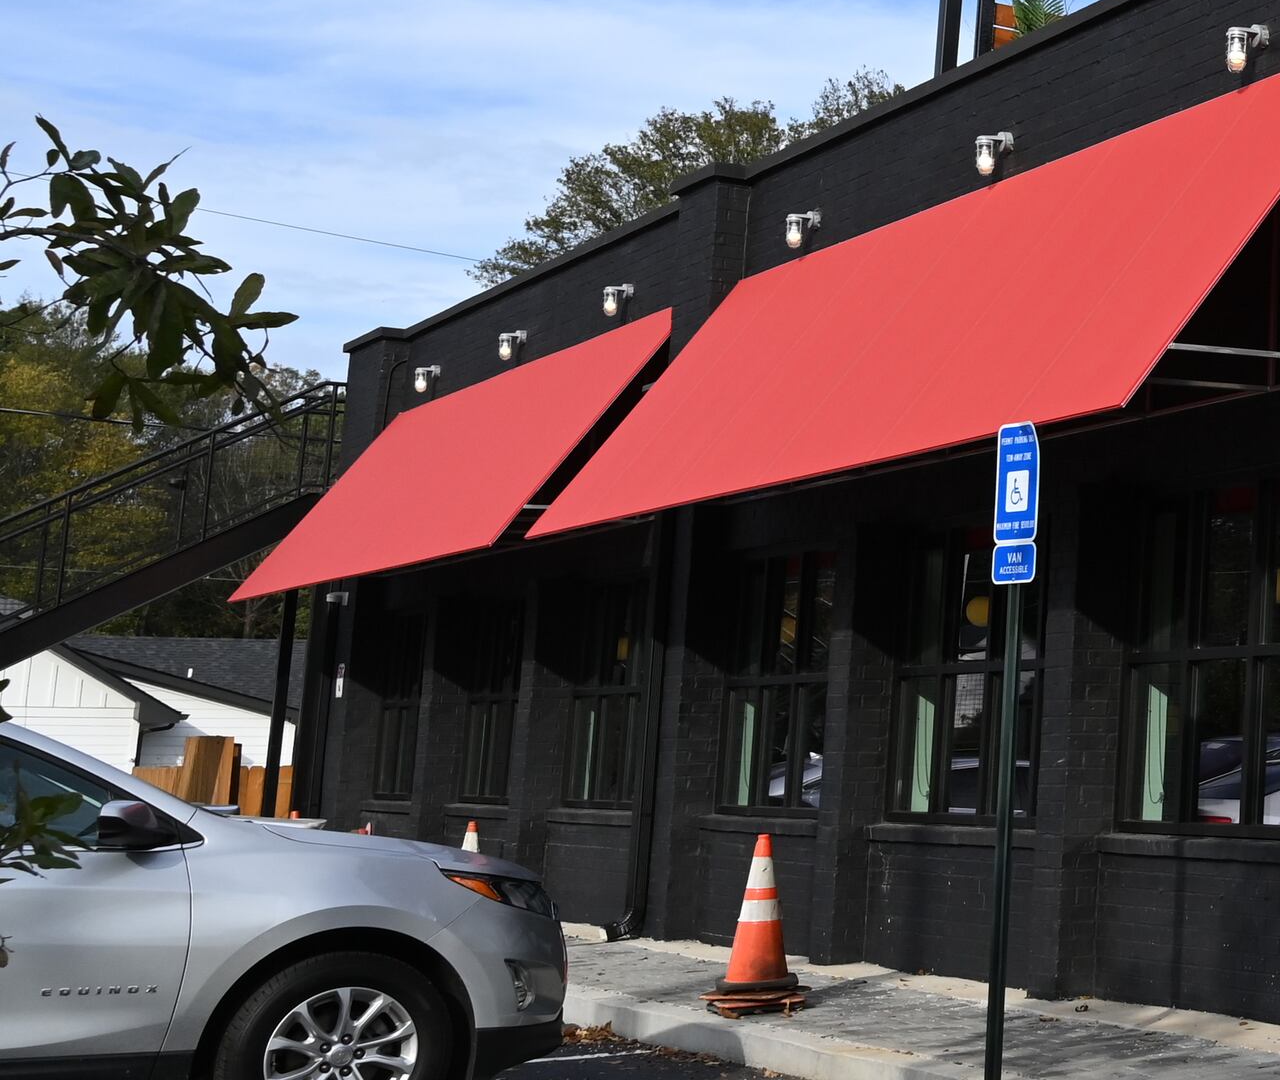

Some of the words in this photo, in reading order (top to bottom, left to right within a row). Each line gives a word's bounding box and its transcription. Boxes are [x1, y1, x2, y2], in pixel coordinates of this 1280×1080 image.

[1007, 551, 1022, 564] VAN
[999, 565, 1028, 575] ACCESSIBLE
[40, 984, 159, 997] EQUINOX
